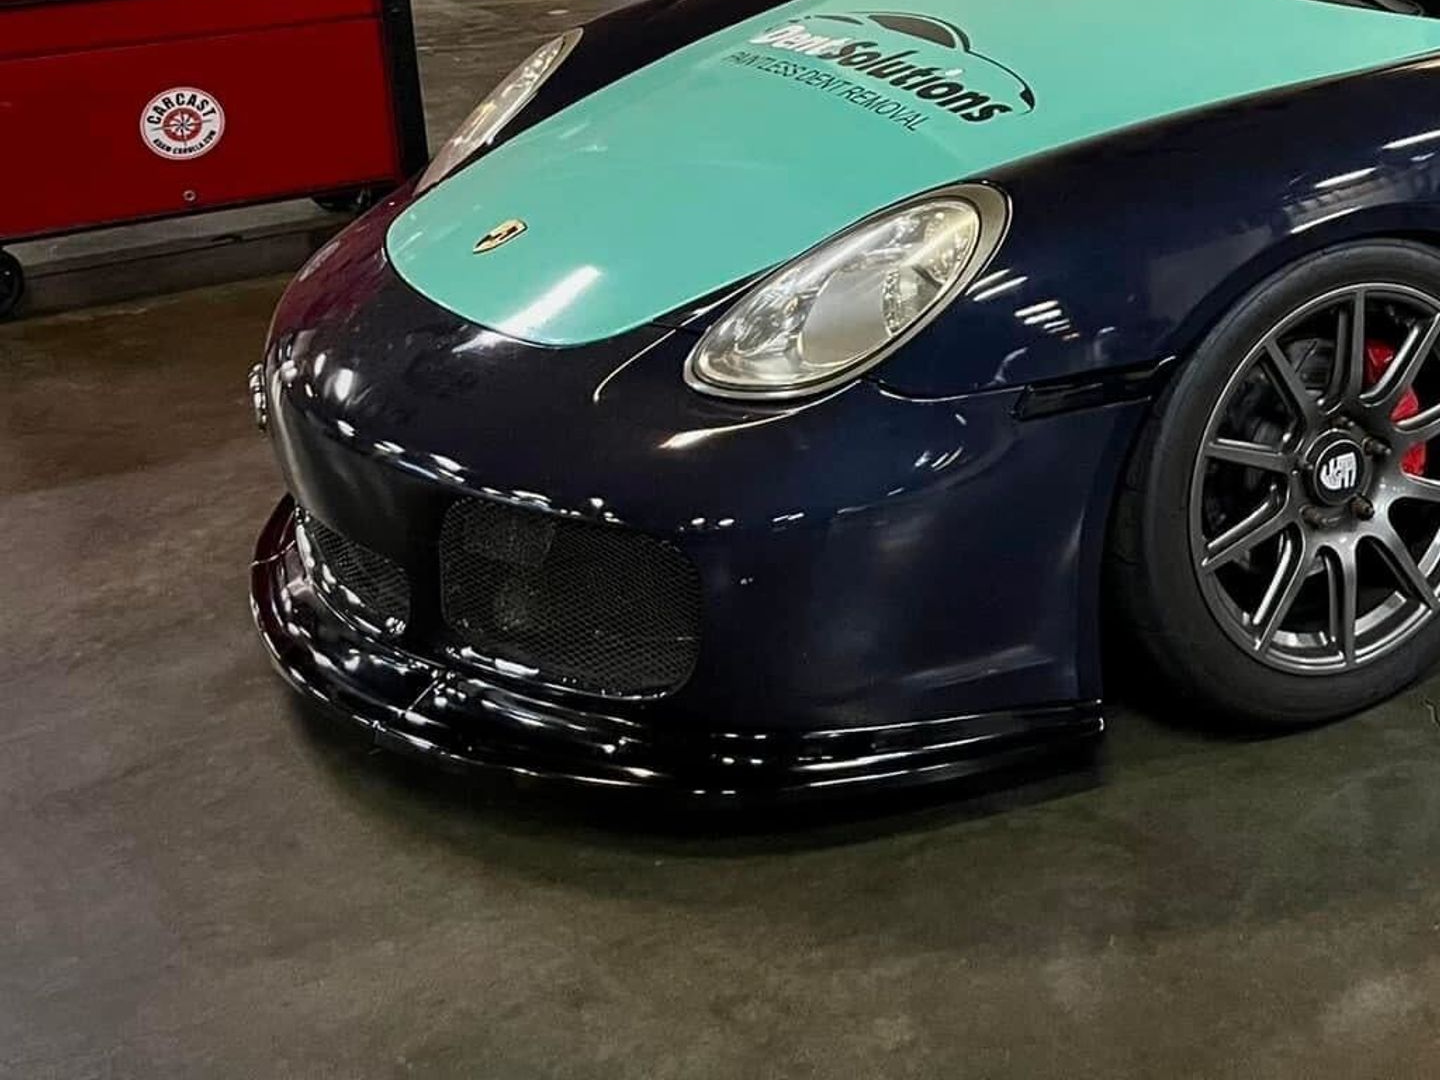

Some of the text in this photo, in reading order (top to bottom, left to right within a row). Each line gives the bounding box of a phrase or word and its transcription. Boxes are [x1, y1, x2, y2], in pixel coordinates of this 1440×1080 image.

[146, 92, 217, 125] CARCAST
[725, 51, 930, 132] PAINTLESS DENT REMOVAL
